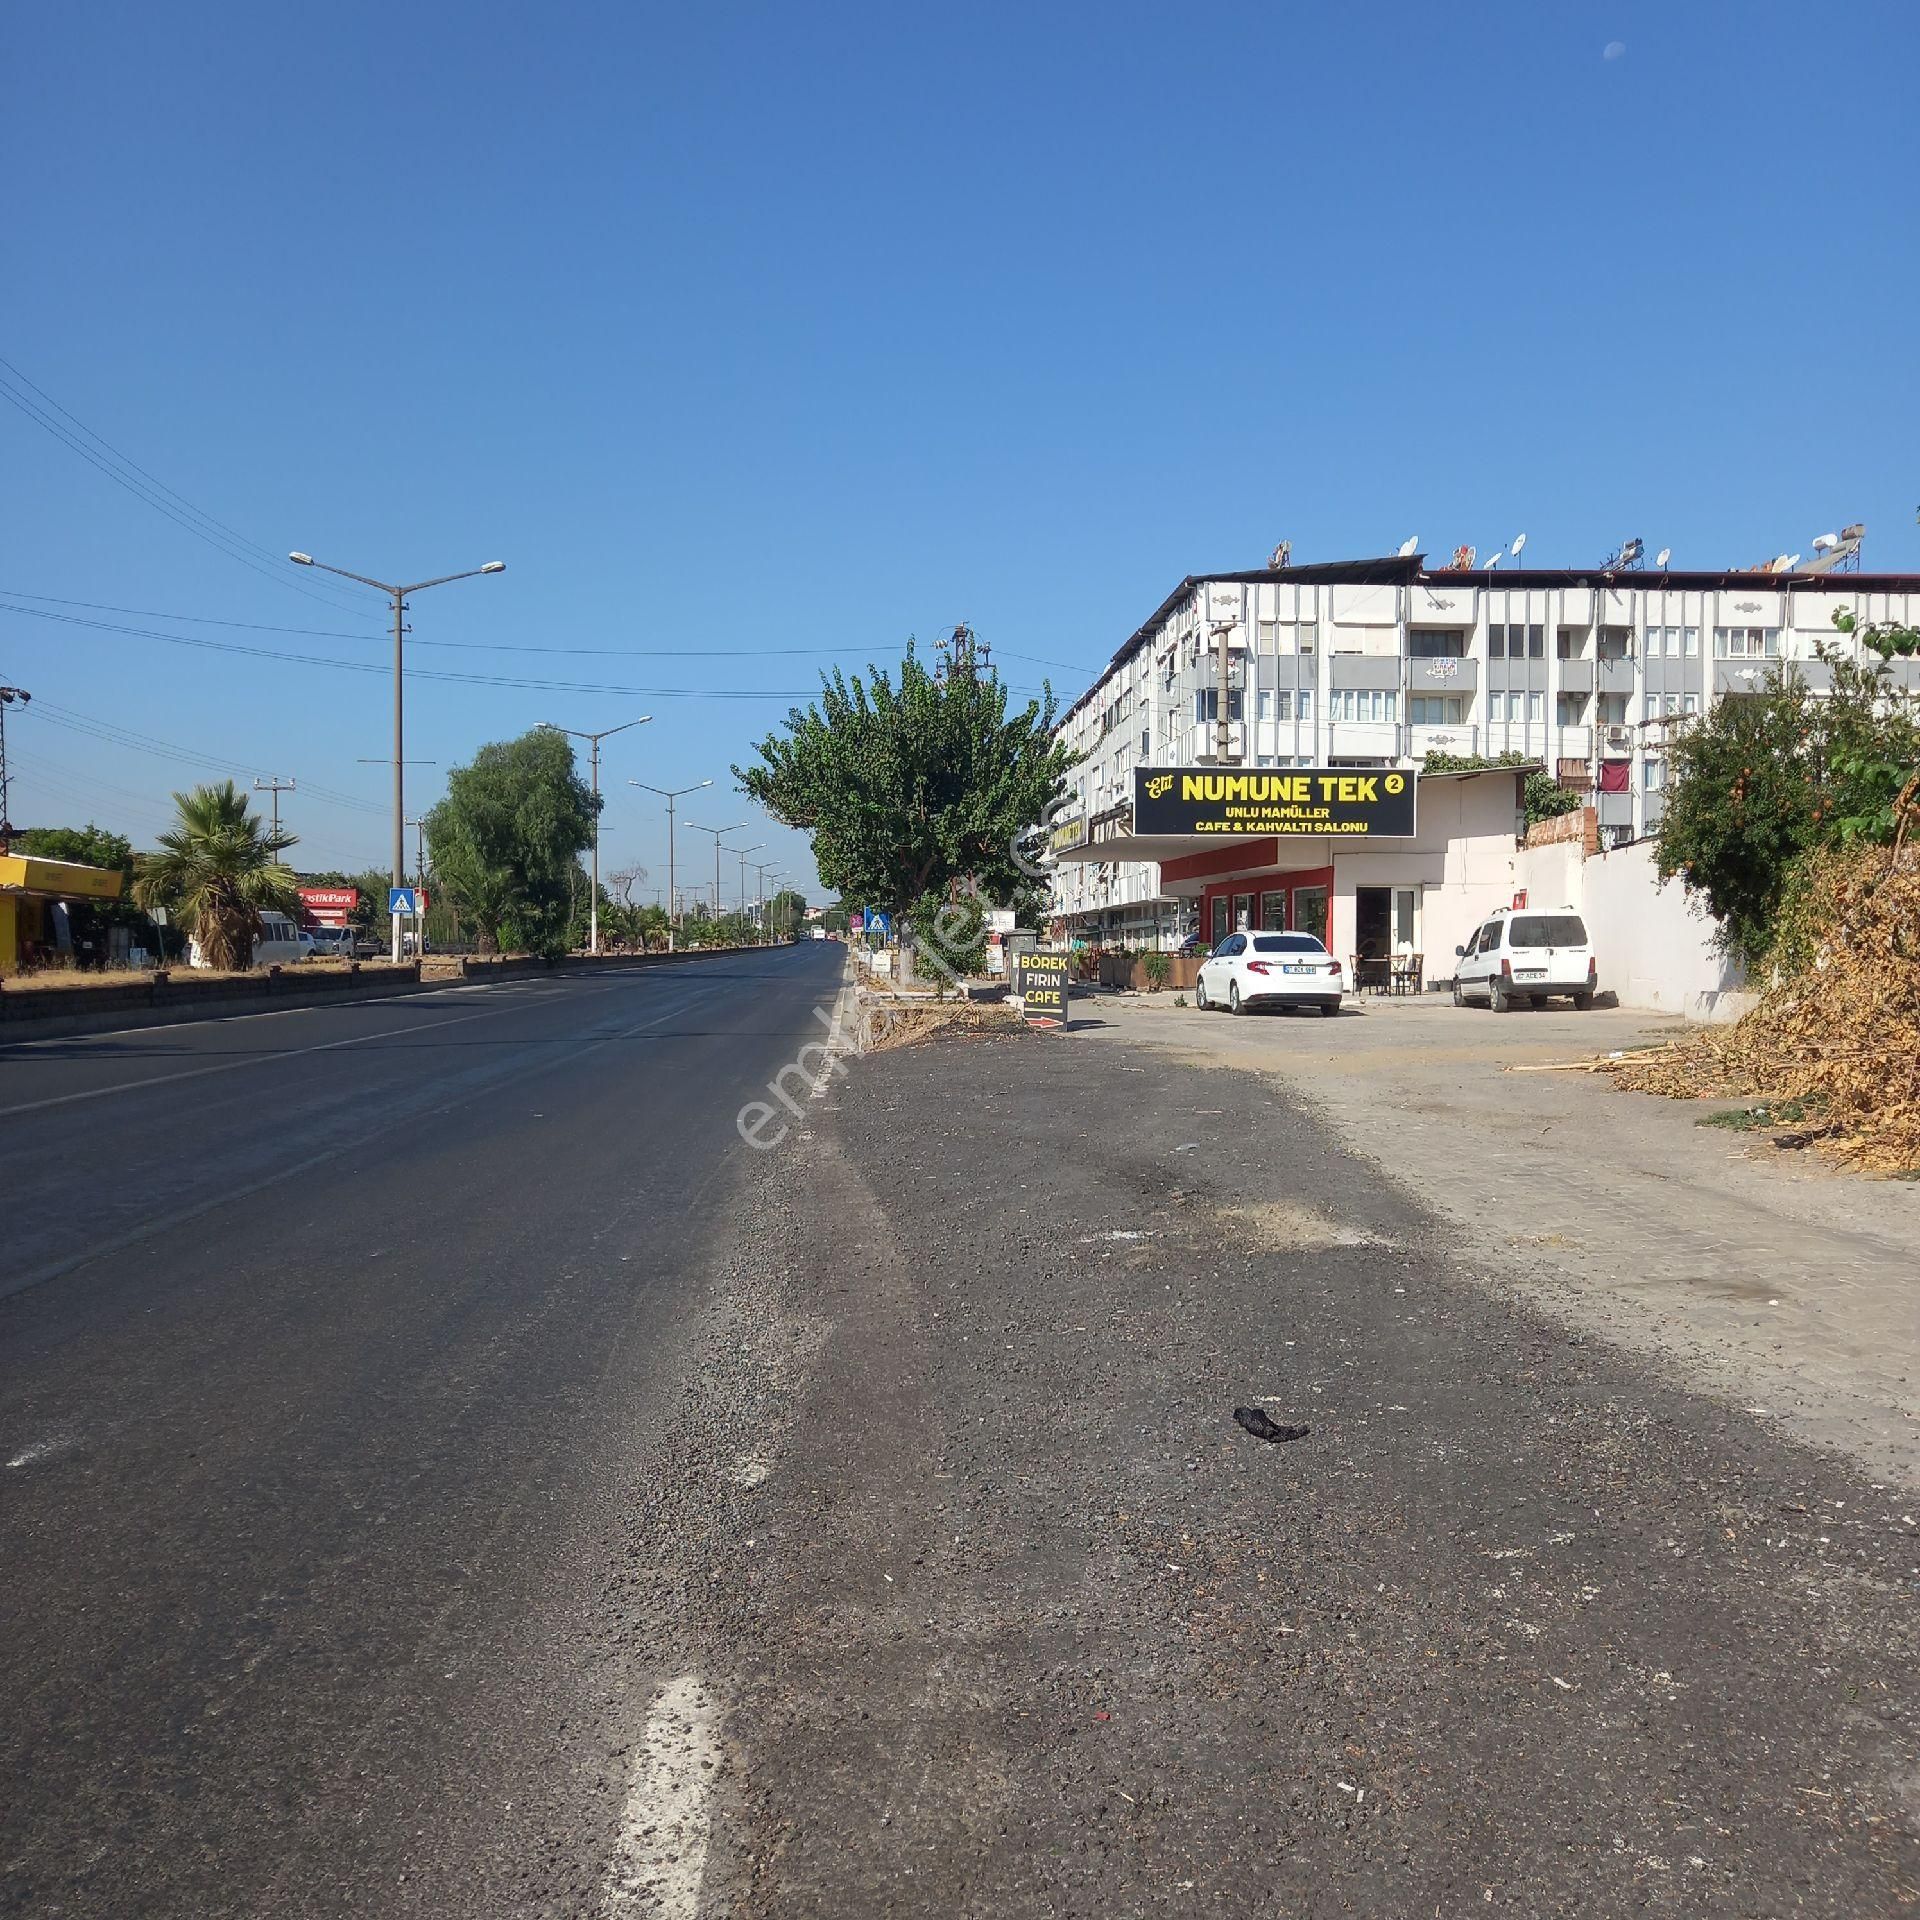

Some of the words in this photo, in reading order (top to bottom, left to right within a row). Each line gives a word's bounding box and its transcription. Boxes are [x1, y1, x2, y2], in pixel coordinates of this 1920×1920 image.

[1145, 774, 1174, 799] Elit
[1182, 775, 1311, 801] NUMUNE
[1318, 777, 1378, 801] TEK
[1225, 806, 1259, 818] UNLU
[1261, 804, 1330, 818] MAMÜLLER
[1195, 821, 1231, 832] CAFE
[1233, 821, 1243, 832] &
[1246, 822, 1312, 832] KAHVALTI
[1314, 822, 1368, 833] SALONU
[1021, 954, 1068, 971] BÖREK
[1026, 973, 1061, 987] FIRIN
[1025, 990, 1061, 1004] CAFE
